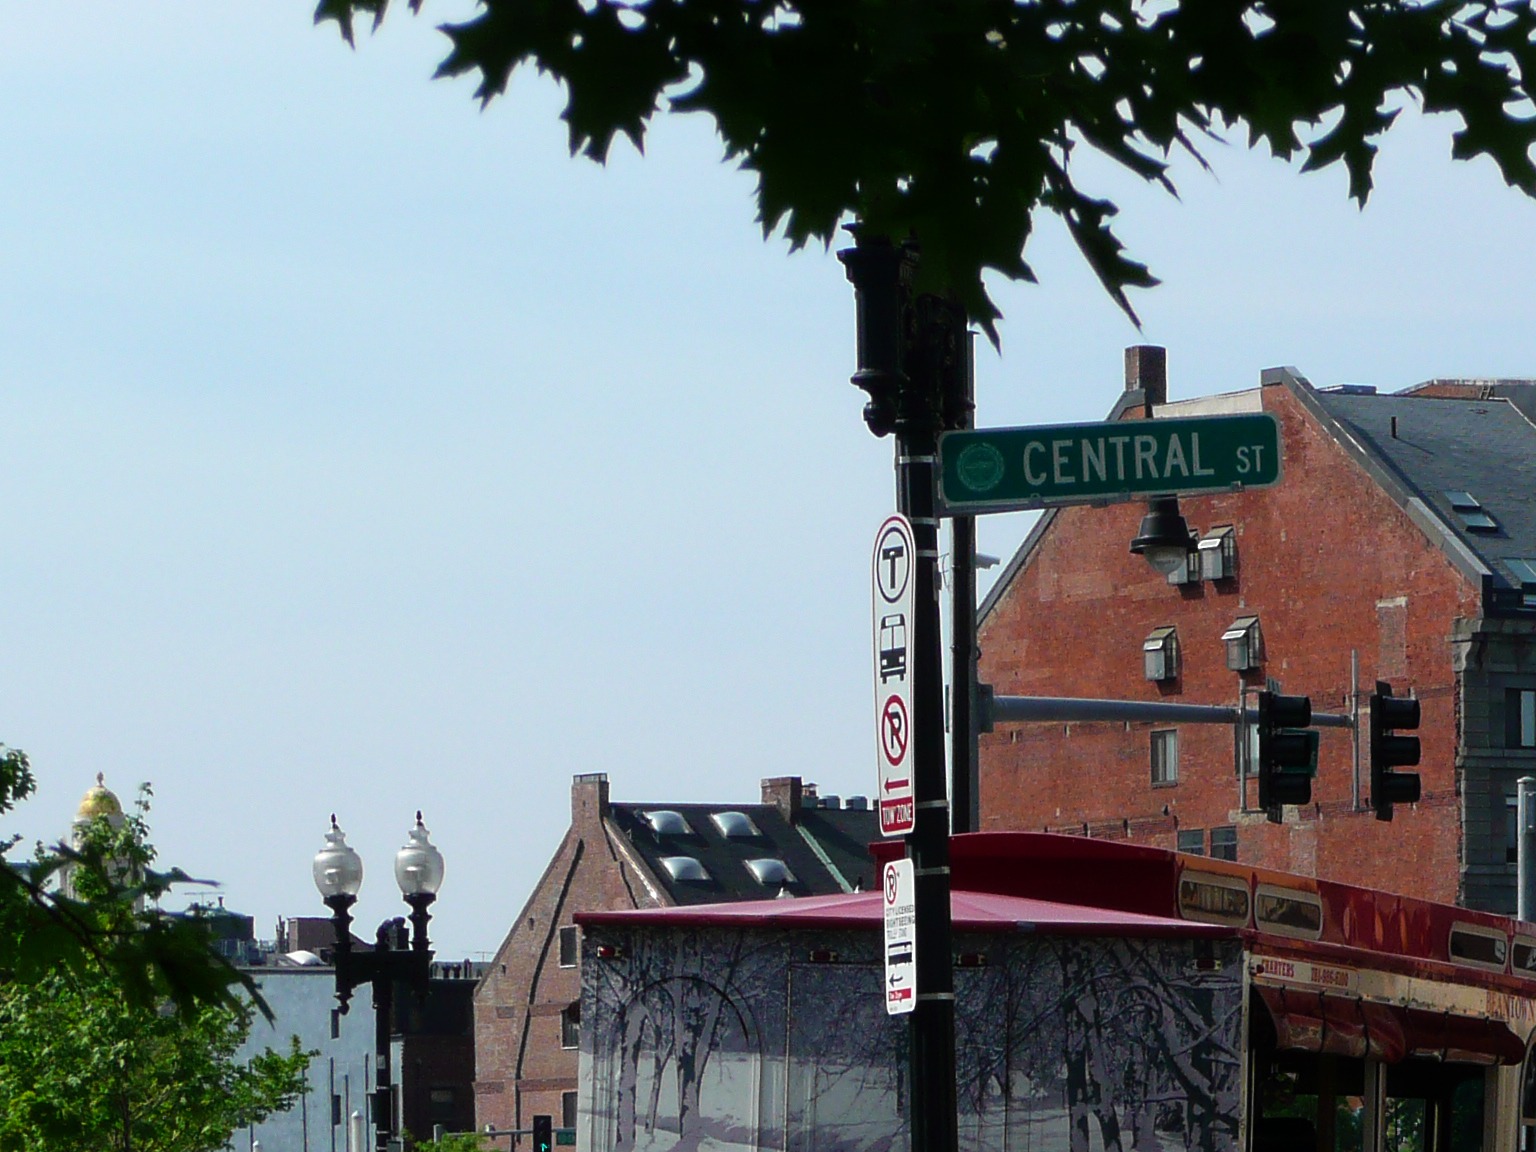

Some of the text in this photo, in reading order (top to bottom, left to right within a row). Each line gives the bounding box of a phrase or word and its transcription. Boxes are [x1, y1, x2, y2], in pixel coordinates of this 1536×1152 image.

[1022, 431, 1265, 487] CENTRAL ST
[897, 802, 913, 824] ZONE
